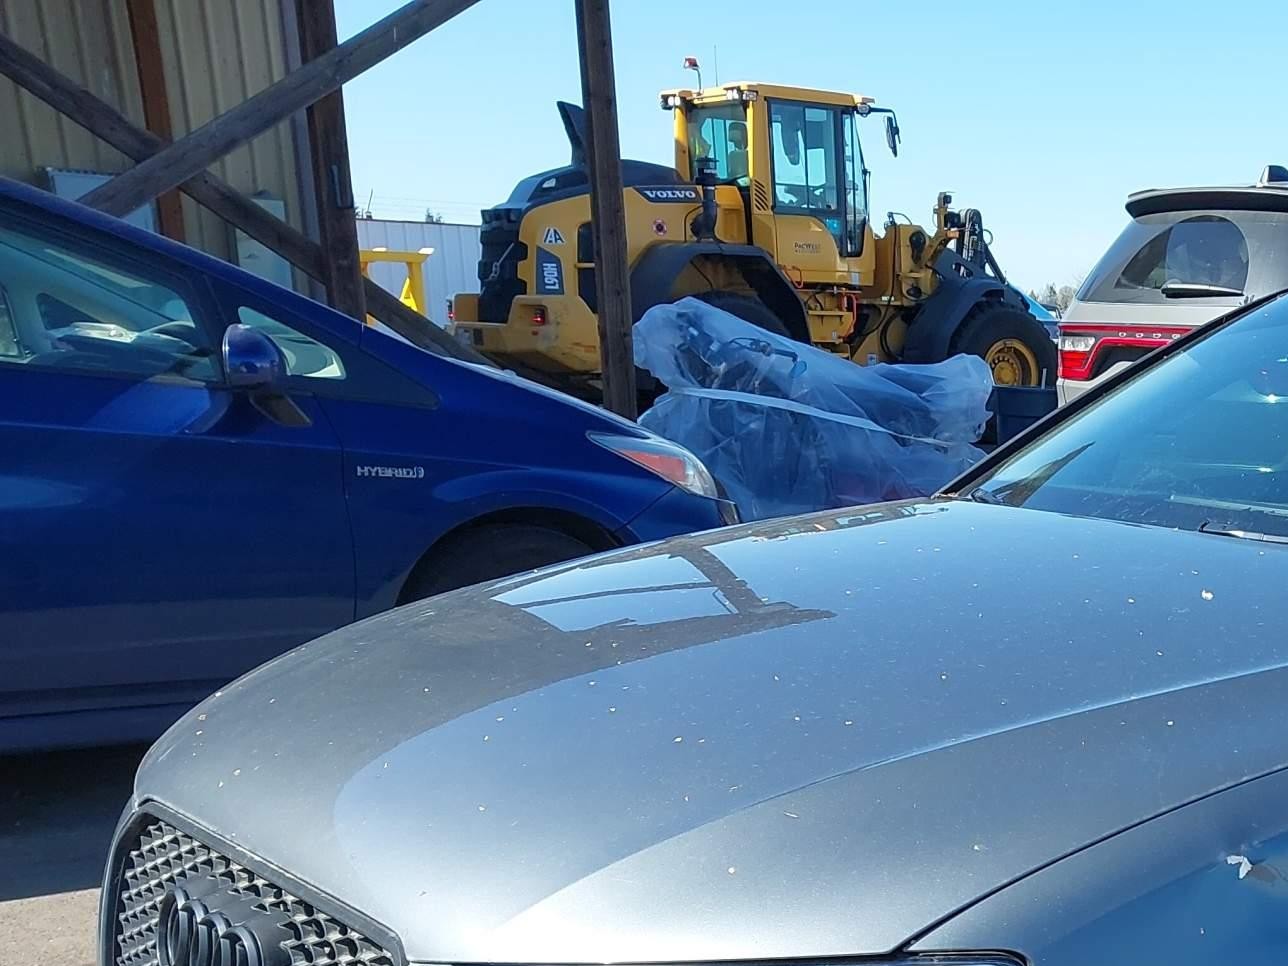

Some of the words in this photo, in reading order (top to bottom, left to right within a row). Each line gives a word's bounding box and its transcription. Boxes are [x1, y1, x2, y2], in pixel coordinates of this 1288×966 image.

[644, 190, 696, 199] VOLVO
[542, 262, 560, 290] L90H
[356, 465, 415, 478] HYBRID
